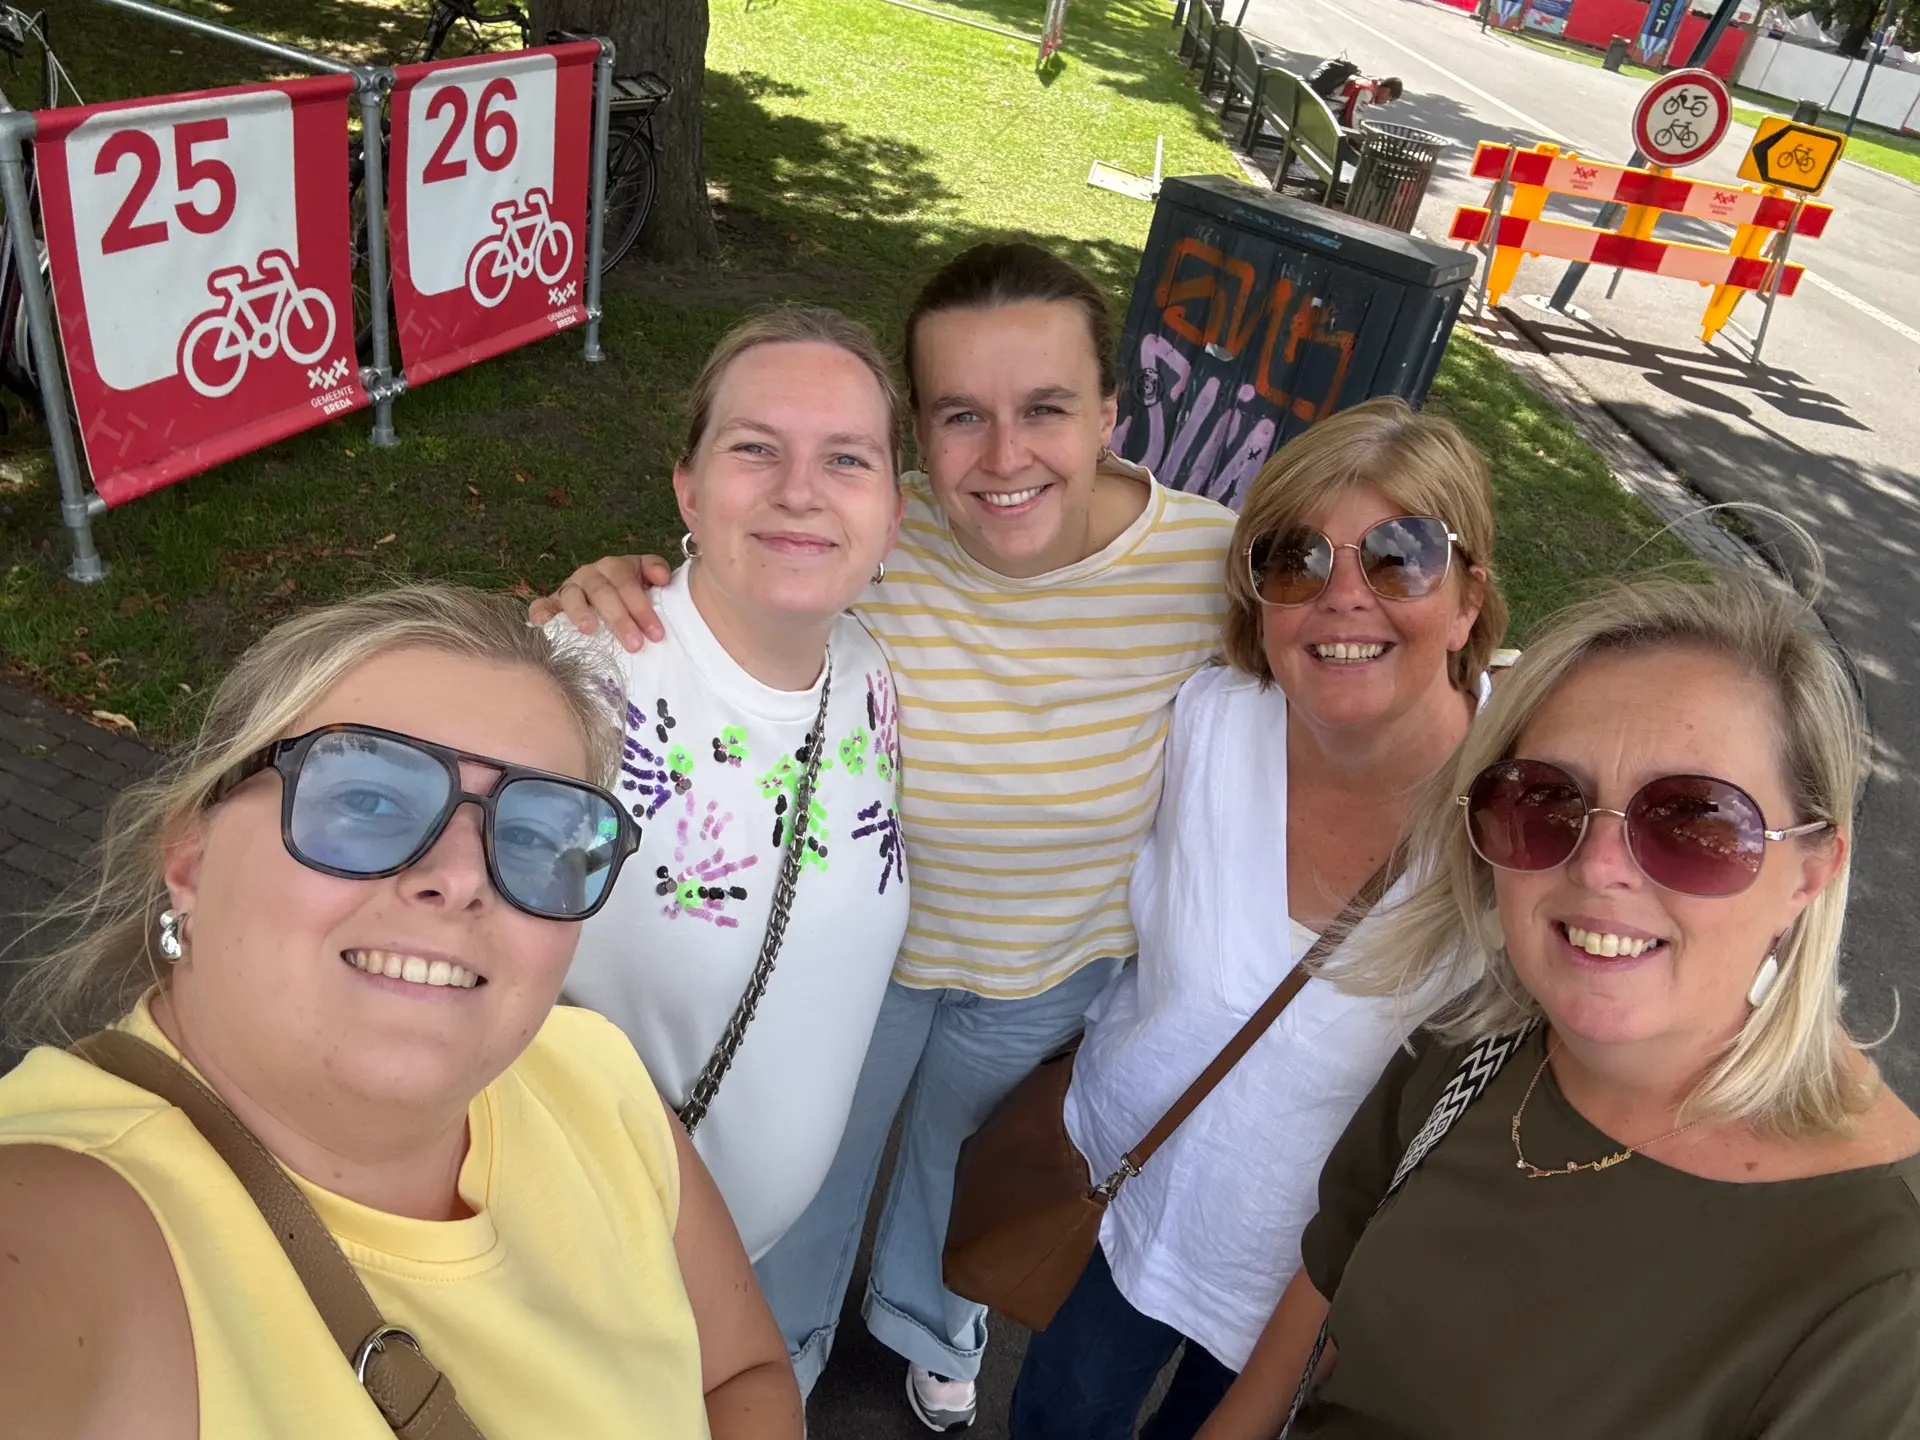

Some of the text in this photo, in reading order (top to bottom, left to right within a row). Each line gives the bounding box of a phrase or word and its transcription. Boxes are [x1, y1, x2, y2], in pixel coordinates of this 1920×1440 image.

[422, 77, 518, 185] 26
[94, 118, 237, 255] 25
[311, 385, 354, 408] GEMEENTE
[323, 397, 353, 415] BREDA
